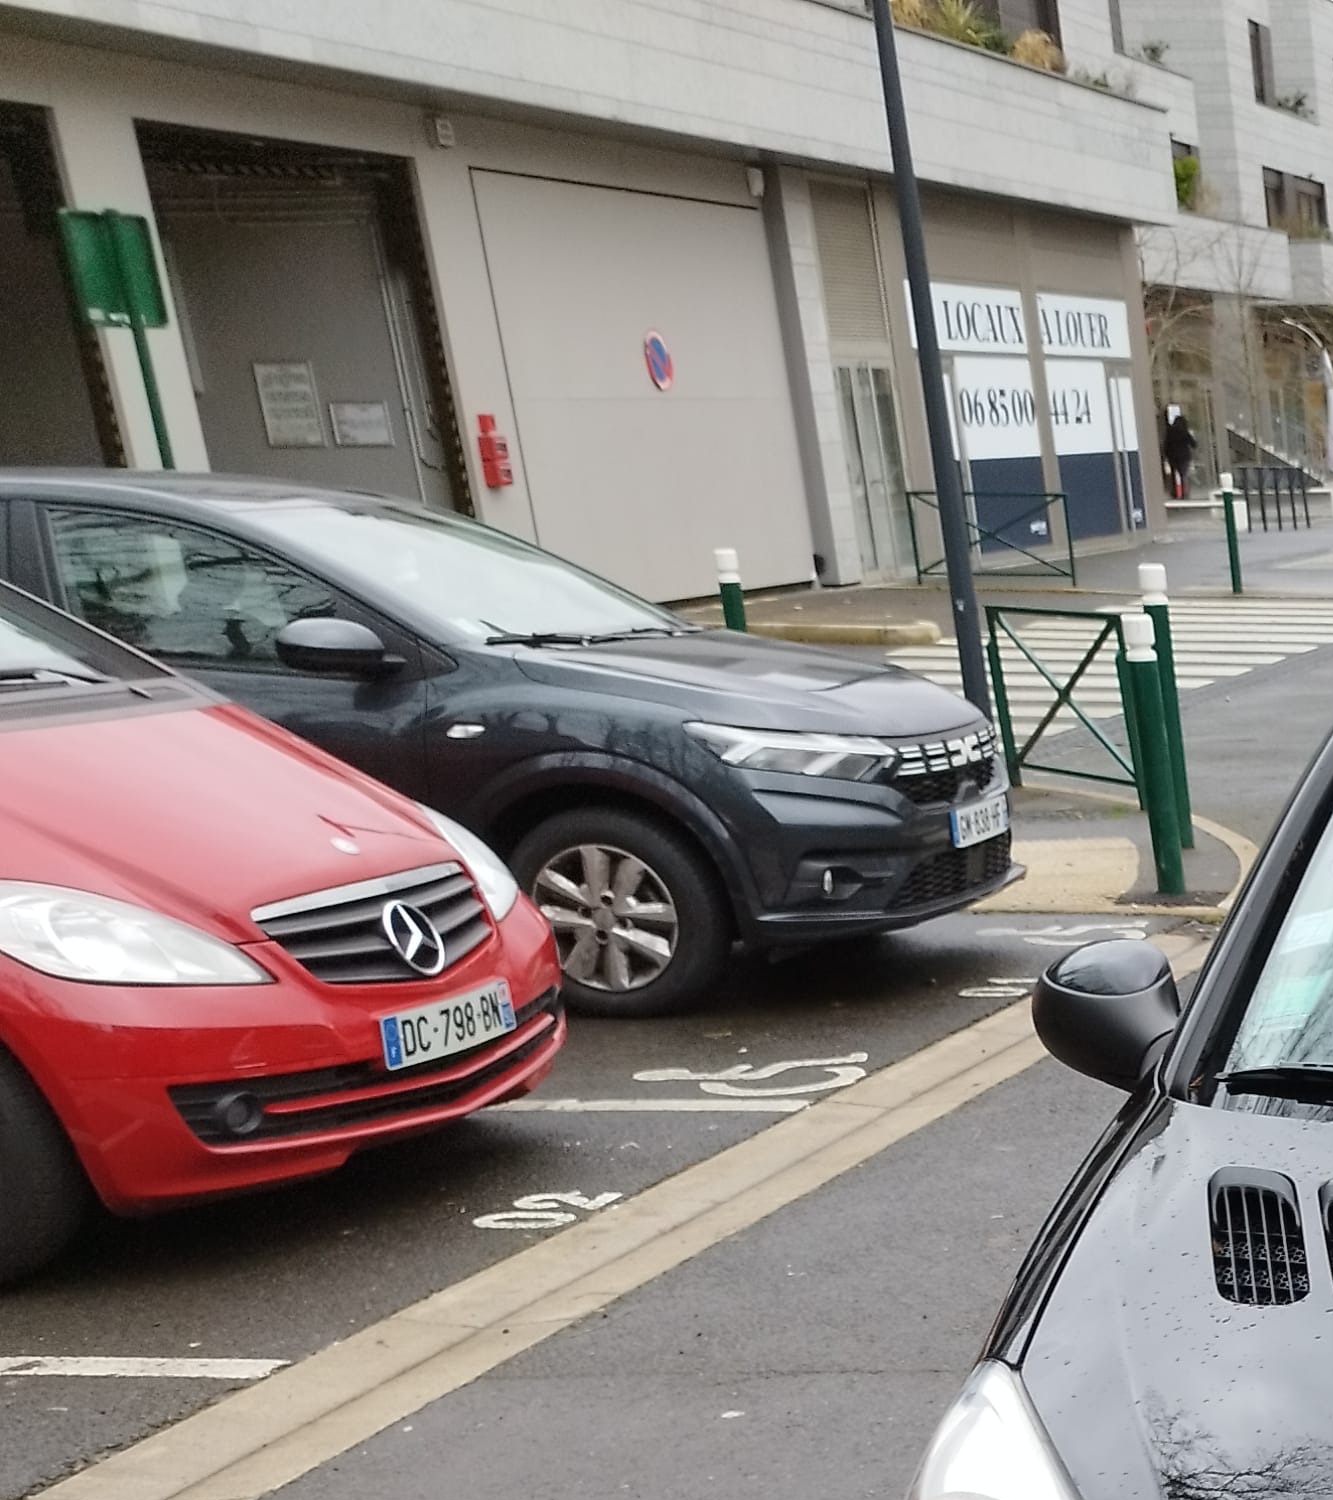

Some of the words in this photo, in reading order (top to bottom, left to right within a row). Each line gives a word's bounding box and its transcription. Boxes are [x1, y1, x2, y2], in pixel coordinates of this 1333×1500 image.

[942, 300, 1025, 345] LOCAUX
[1055, 310, 1111, 349] LOUER
[960, 388, 985, 428] 06
[987, 387, 1010, 428] 85
[1011, 388, 1035, 427] 00
[1050, 390, 1068, 425] 44
[1073, 388, 1092, 425] 24
[401, 992, 503, 1057] DC-798-BN
